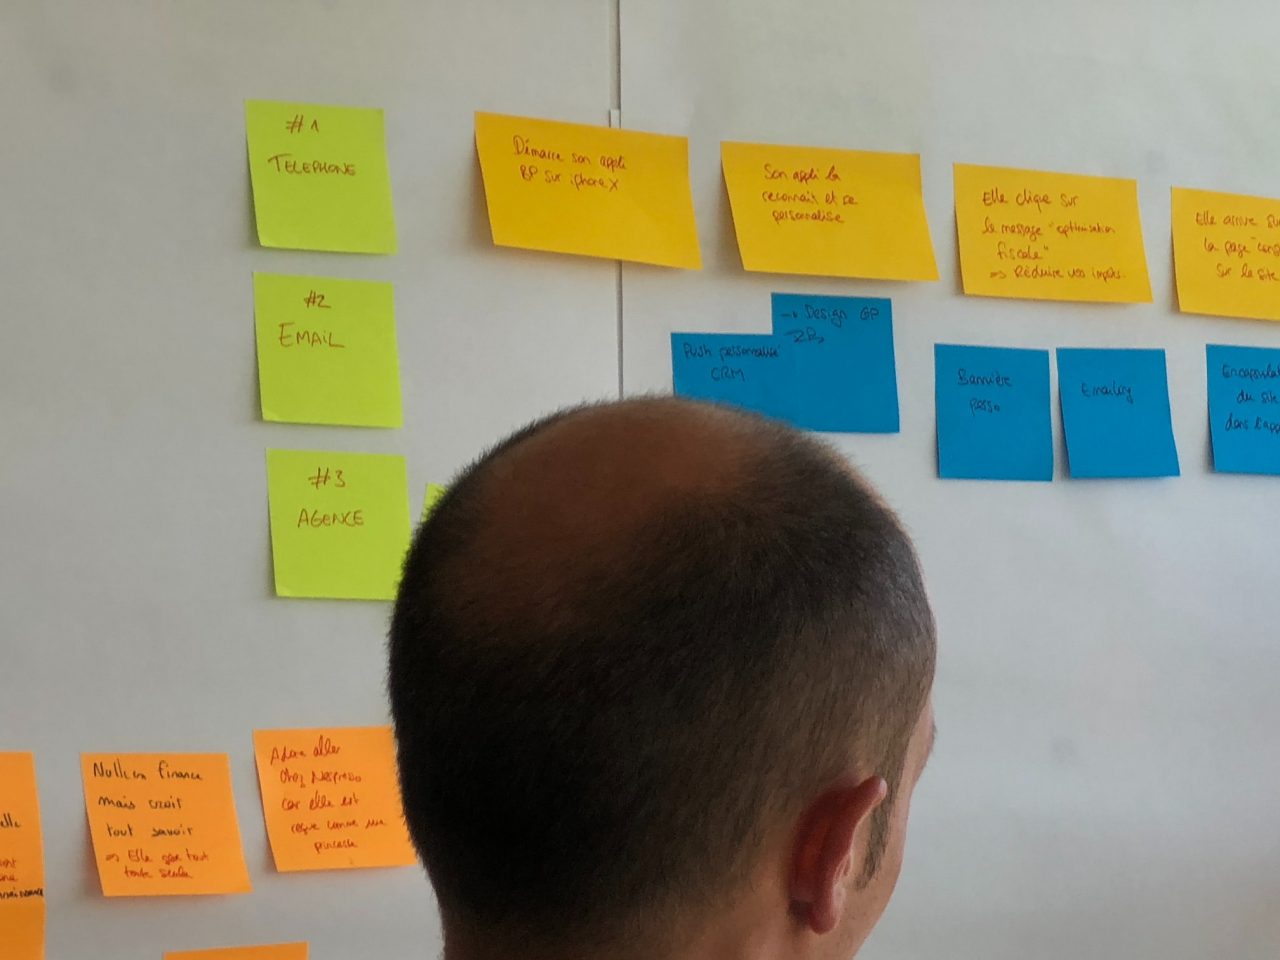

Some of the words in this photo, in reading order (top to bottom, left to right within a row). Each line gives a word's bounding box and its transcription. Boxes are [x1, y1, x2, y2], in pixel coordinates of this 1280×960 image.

[267, 153, 357, 176] TELEPHONE
[982, 187, 1009, 207] Elle
[1015, 189, 1051, 213] clique
[1001, 223, 1043, 241] message
[1224, 239, 1250, 258] page
[303, 289, 332, 308] #2
[308, 467, 347, 490] #3
[98, 796, 136, 809] mais
[106, 823, 133, 837] tout
[151, 824, 193, 837] savoir
